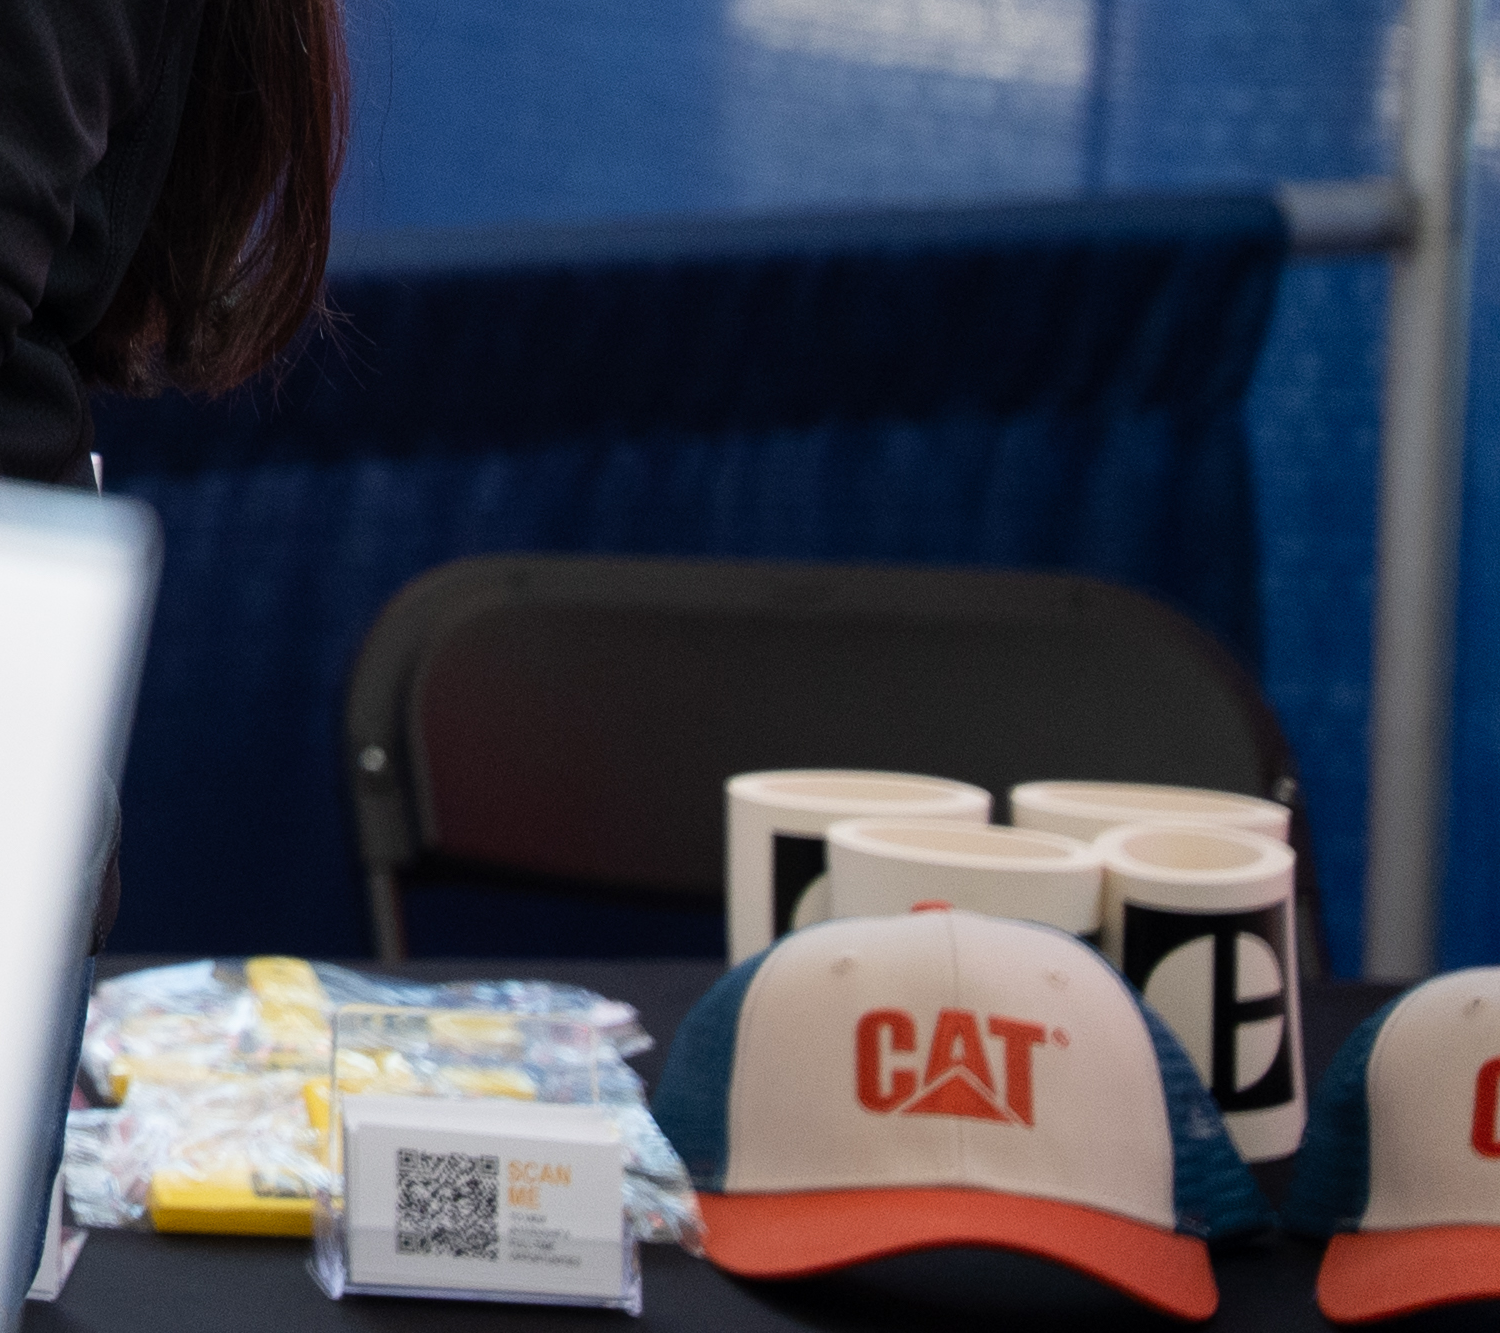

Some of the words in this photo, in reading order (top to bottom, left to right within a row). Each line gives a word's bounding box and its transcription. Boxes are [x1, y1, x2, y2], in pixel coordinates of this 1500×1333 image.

[853, 1008, 1046, 1127] CAT
[508, 1160, 573, 1187] SCAN
[508, 1186, 542, 1210] ME
